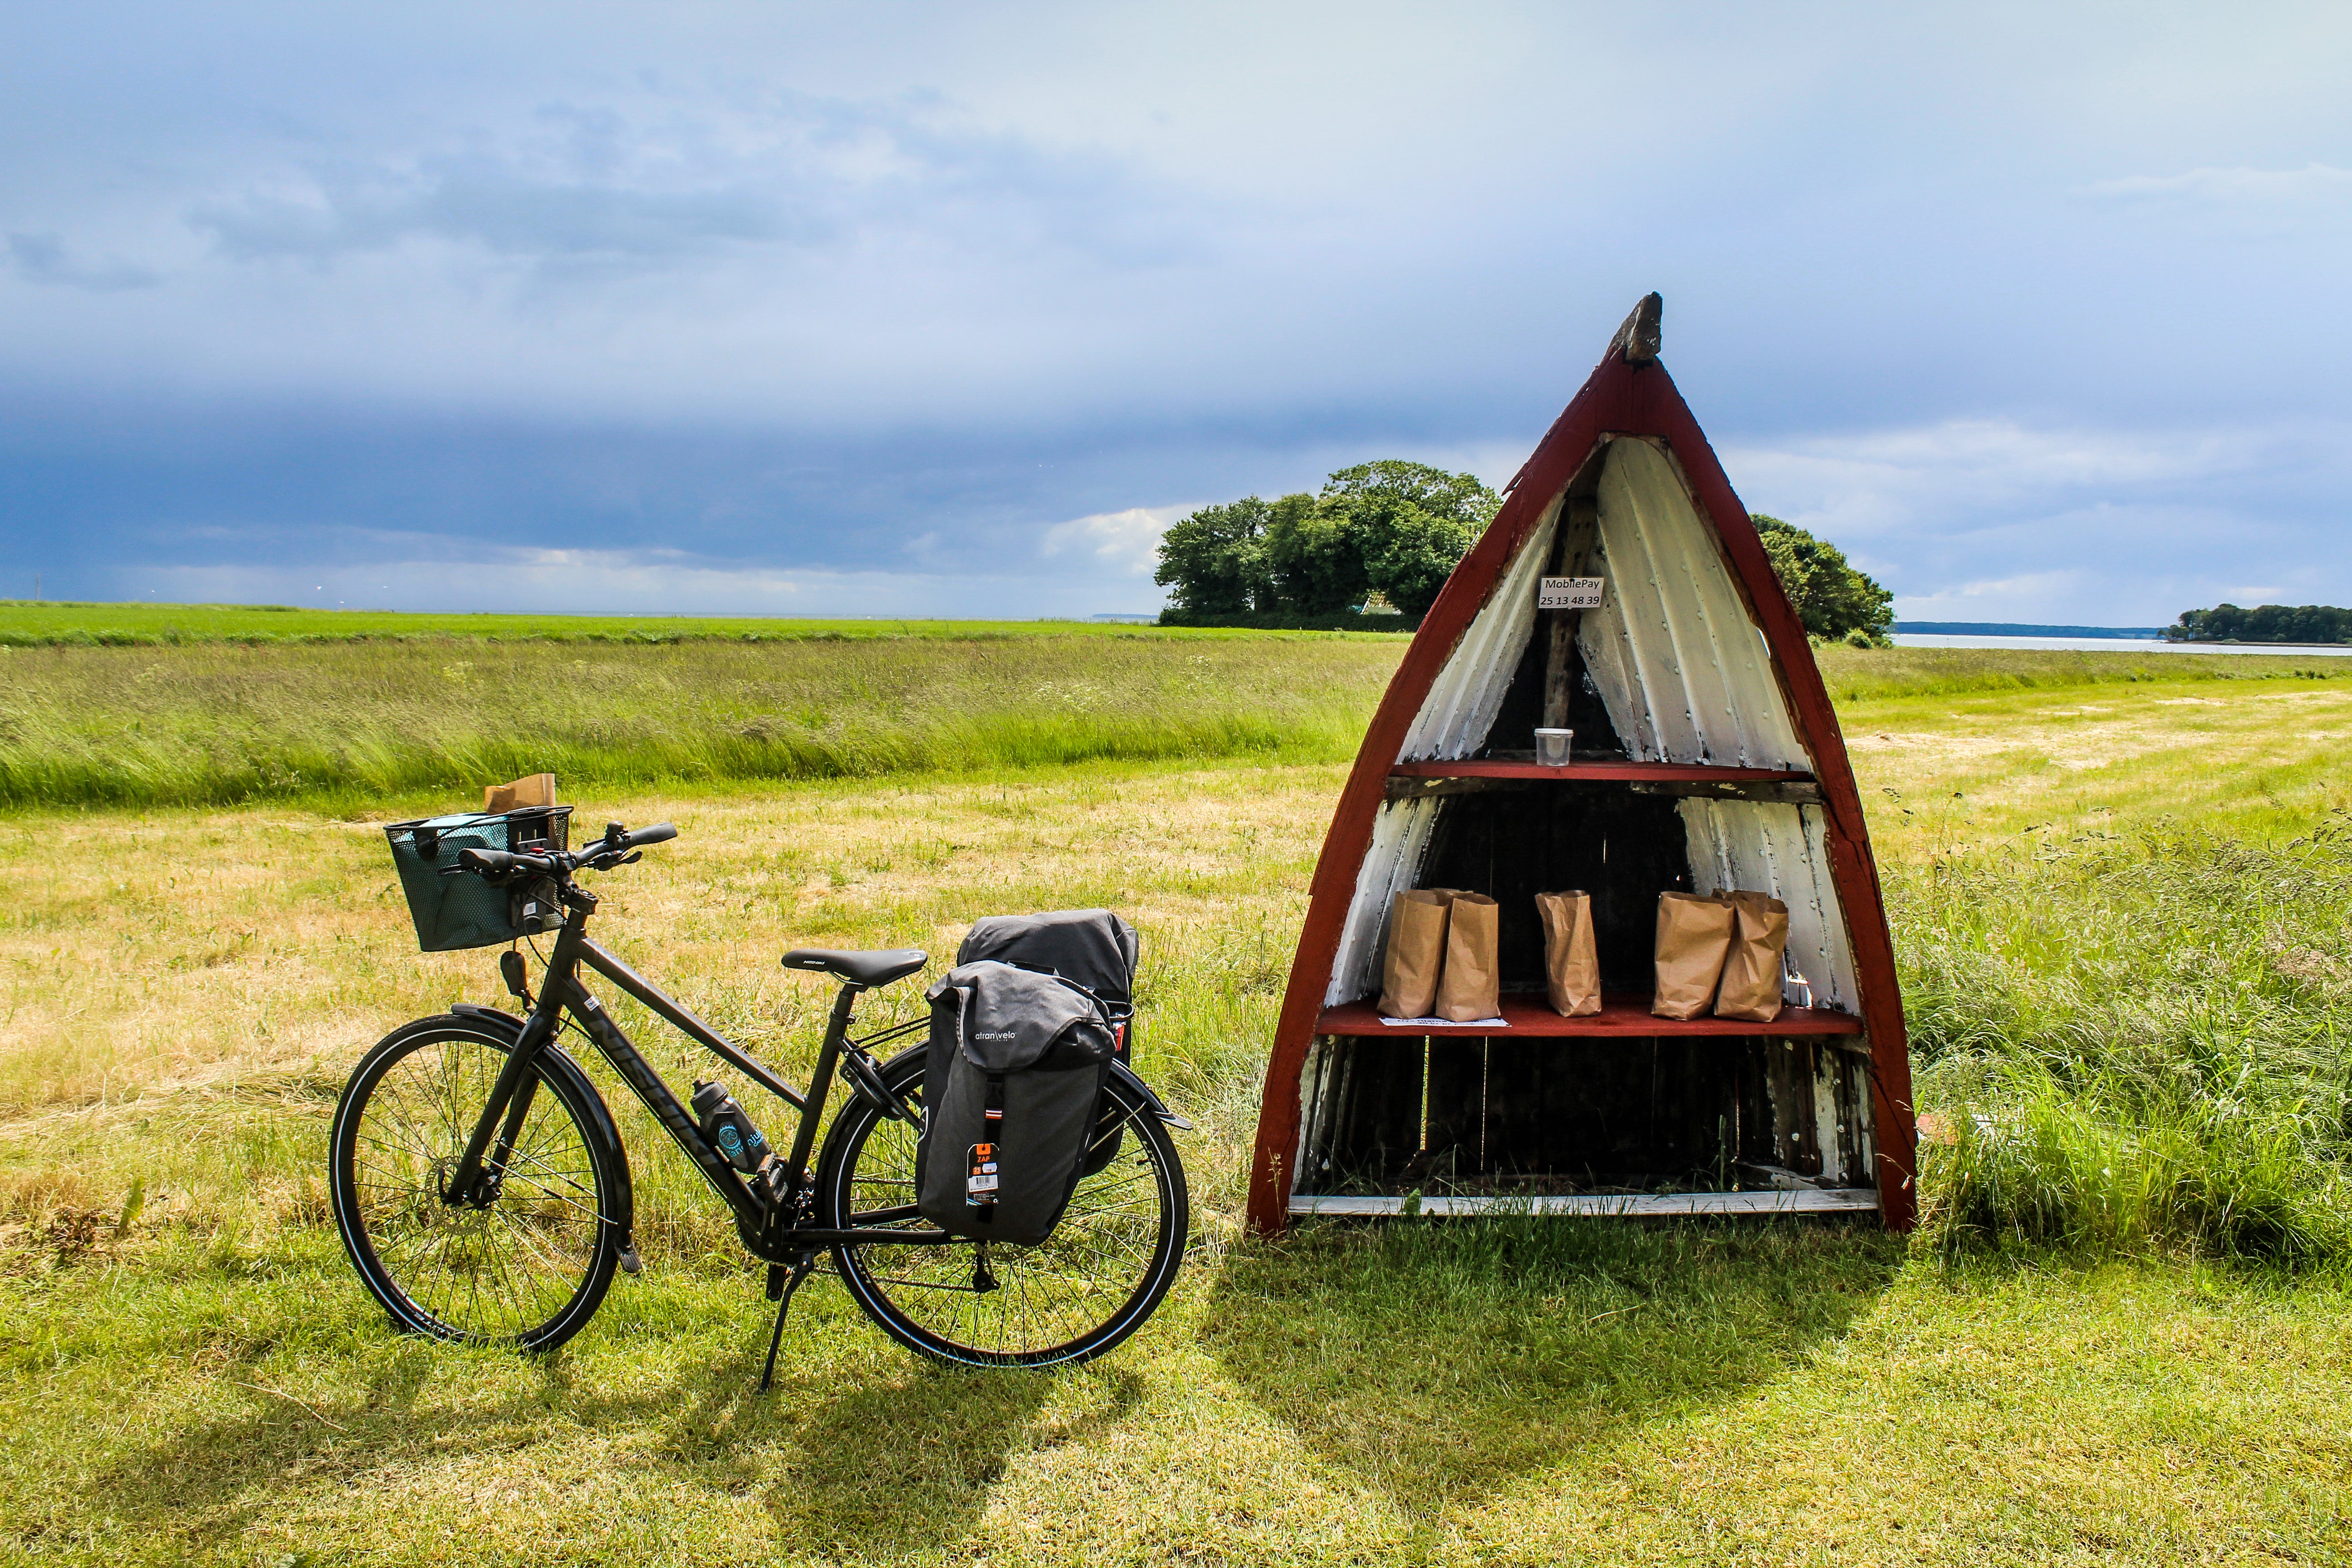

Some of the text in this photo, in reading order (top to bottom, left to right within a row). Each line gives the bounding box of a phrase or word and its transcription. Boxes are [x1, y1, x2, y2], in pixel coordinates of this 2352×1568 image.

[1545, 579, 1599, 589] MobilePay
[1540, 596, 1599, 605] 25 13 48 39
[589, 1019, 719, 1165] NISHIKI
